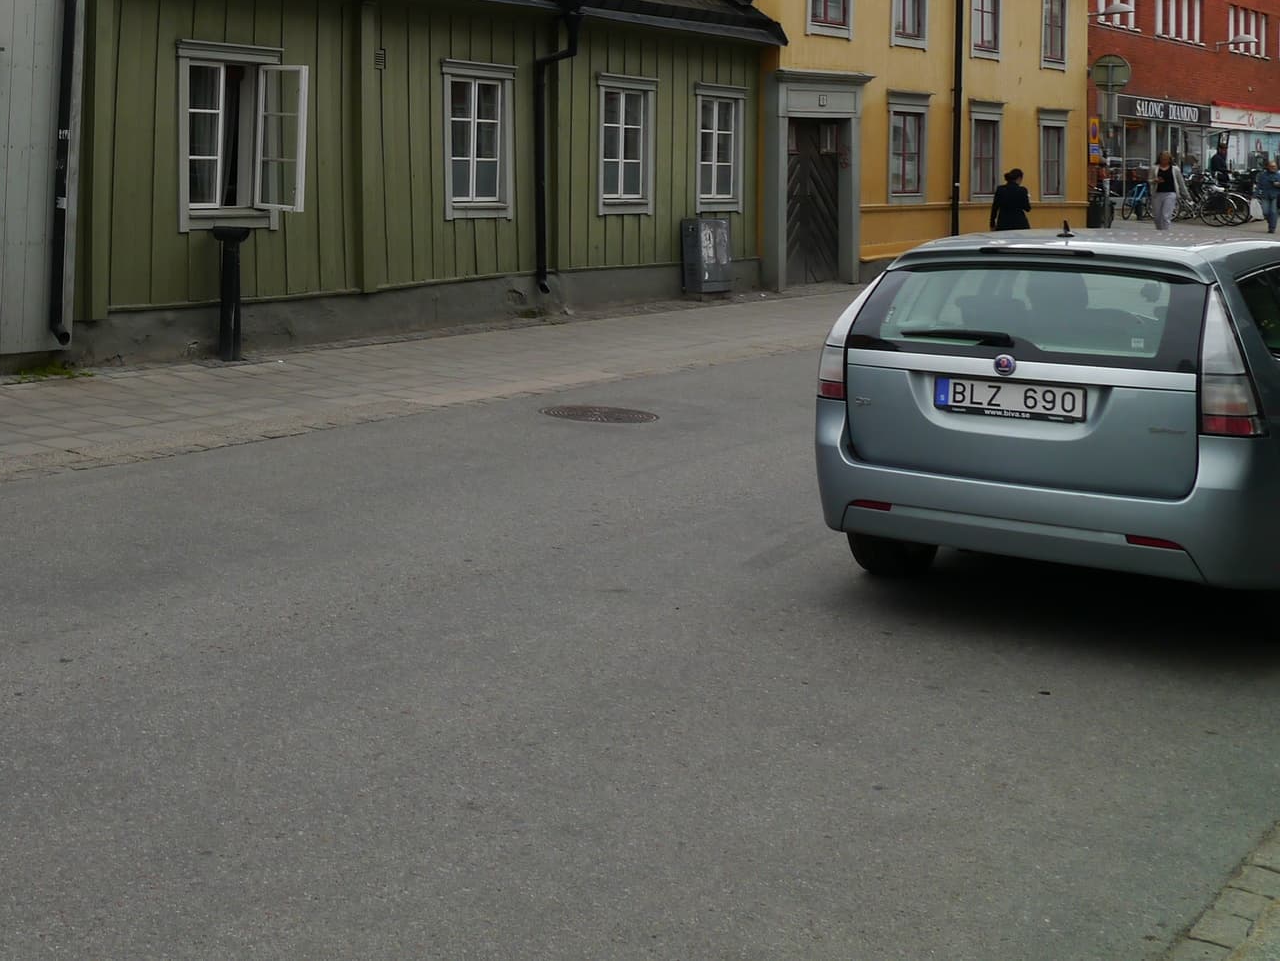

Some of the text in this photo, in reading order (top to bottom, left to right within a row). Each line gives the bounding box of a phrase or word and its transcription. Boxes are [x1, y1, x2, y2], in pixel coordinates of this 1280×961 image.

[1136, 100, 1164, 119] SALONG
[1168, 104, 1199, 122] DIAMOND
[952, 382, 1076, 414] BLZ 690
[984, 408, 1031, 419] www.biva.se
